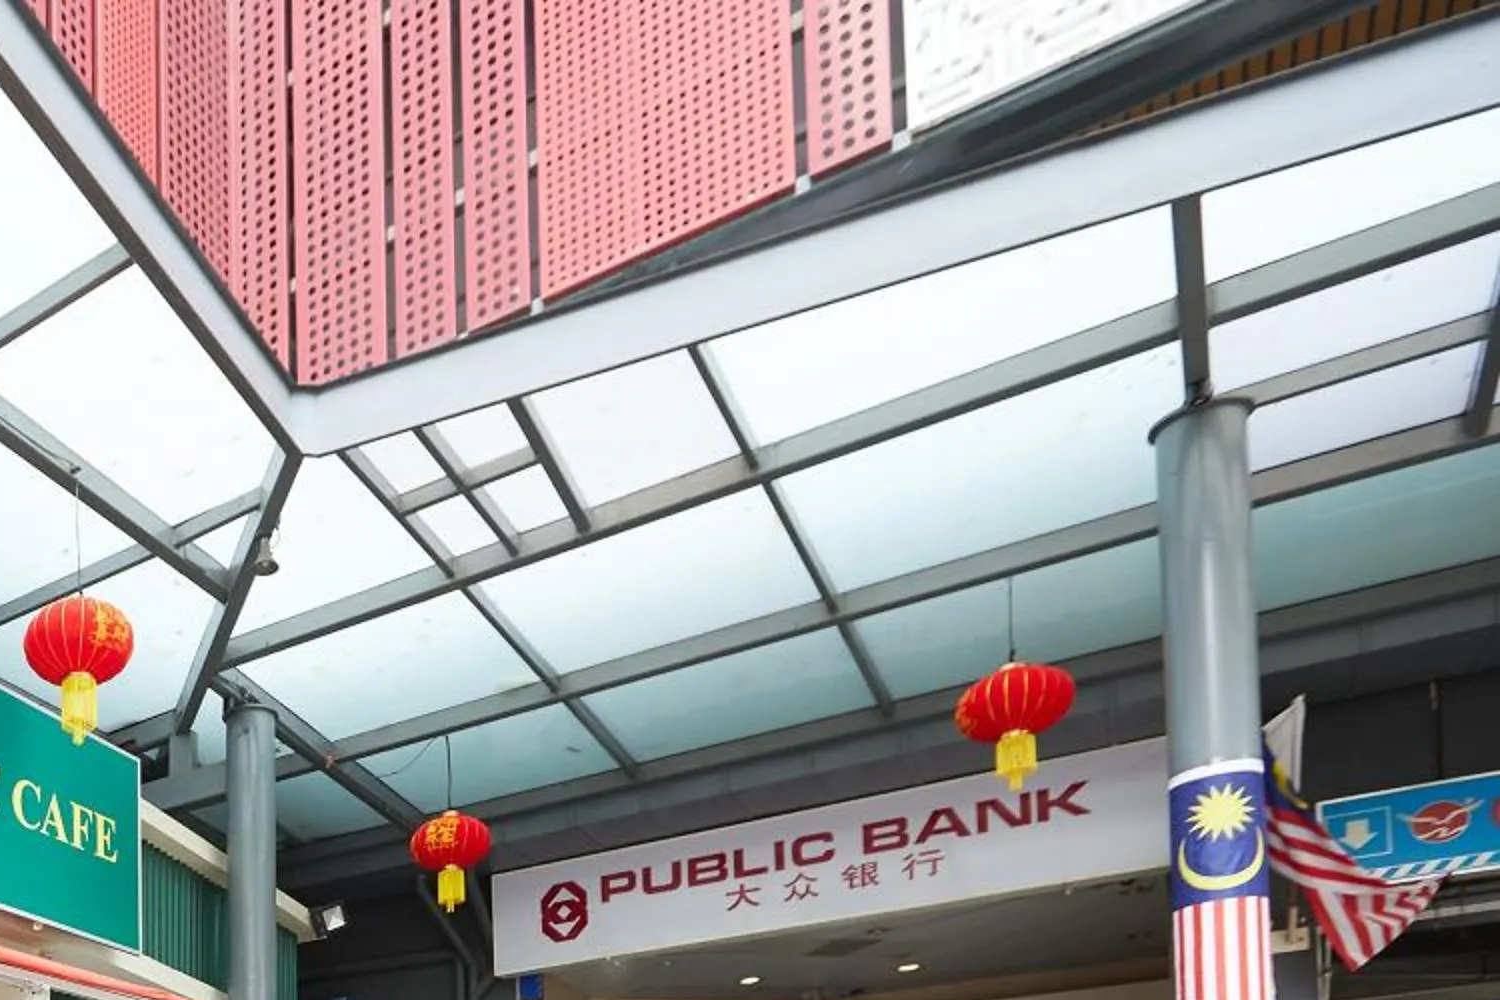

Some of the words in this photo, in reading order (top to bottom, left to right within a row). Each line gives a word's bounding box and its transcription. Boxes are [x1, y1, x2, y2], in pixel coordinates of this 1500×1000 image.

[12, 779, 117, 862] CAFE
[601, 832, 836, 903] PUBLIC
[861, 780, 1091, 855] BANK
[726, 849, 944, 911] 大众银行
